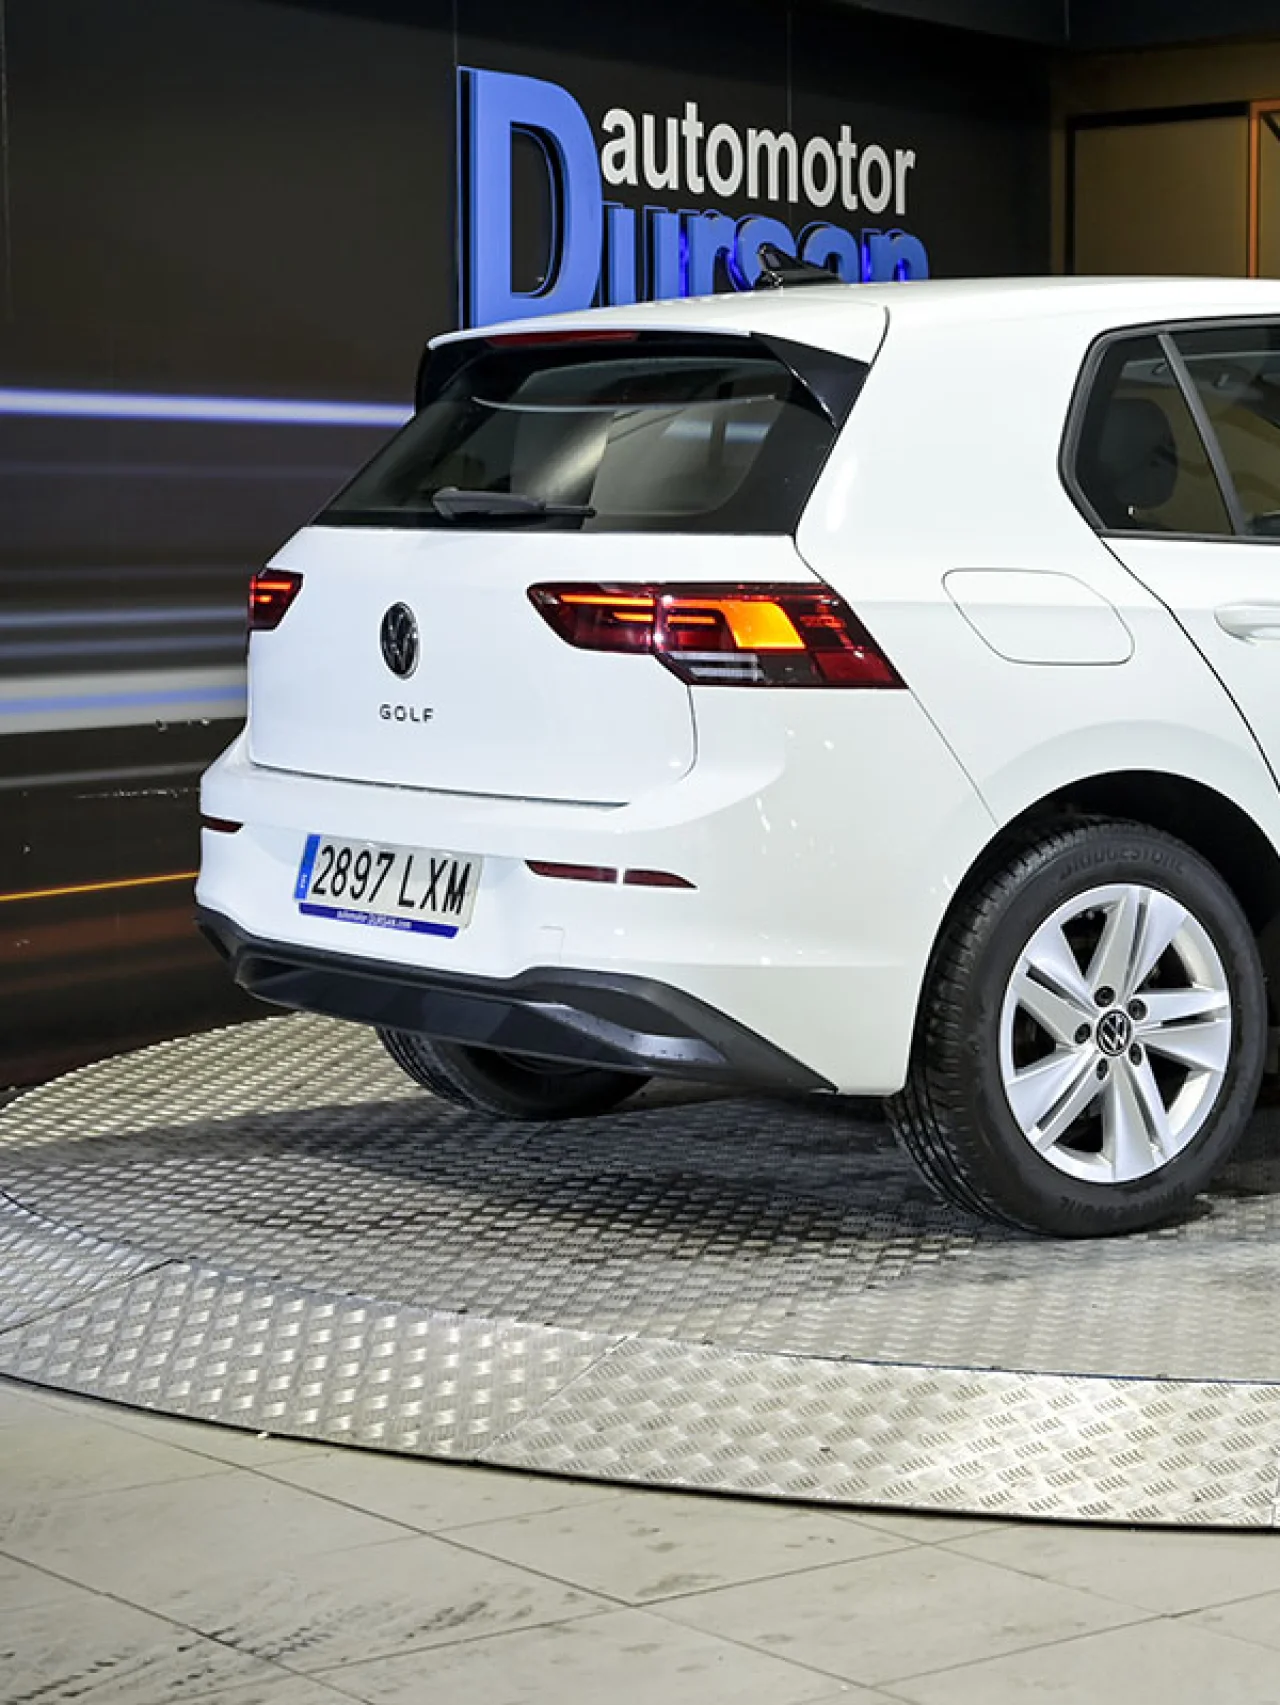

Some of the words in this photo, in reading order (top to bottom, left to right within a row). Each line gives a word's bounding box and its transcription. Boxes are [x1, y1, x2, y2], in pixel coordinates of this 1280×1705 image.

[600, 101, 916, 215] automotor
[380, 703, 434, 722] GOLF
[311, 844, 396, 903] 2897
[397, 853, 473, 915] LXM
